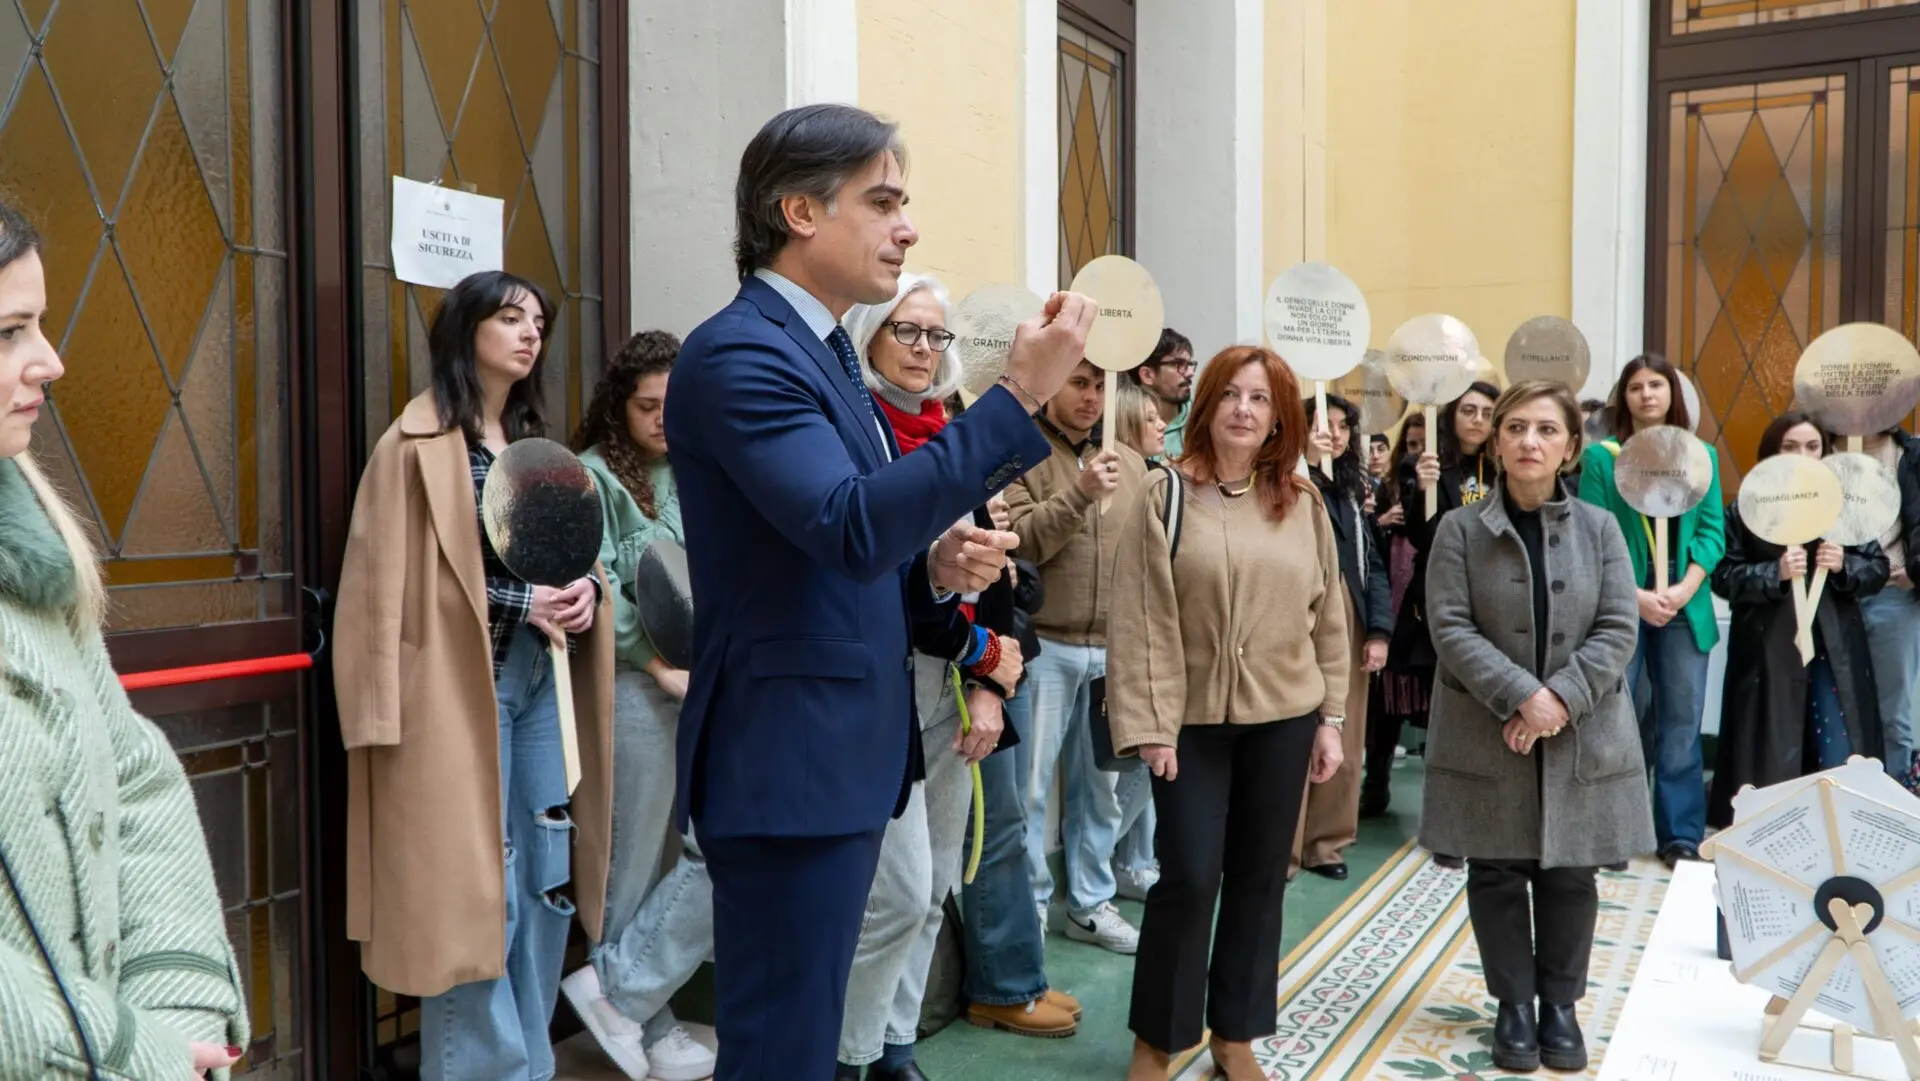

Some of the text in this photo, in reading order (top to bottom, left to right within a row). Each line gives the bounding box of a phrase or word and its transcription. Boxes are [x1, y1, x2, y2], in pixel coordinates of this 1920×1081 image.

[422, 229, 471, 246] USCITA DI
[418, 243, 473, 261] SICUREZZA
[1287, 304, 1313, 313] INVADE
[1308, 298, 1329, 307] DELLE
[1331, 302, 1355, 310] DONNE
[1309, 321, 1338, 329] GIORNO
[1277, 333, 1304, 342] DONNA
[1305, 336, 1322, 344] VITA
